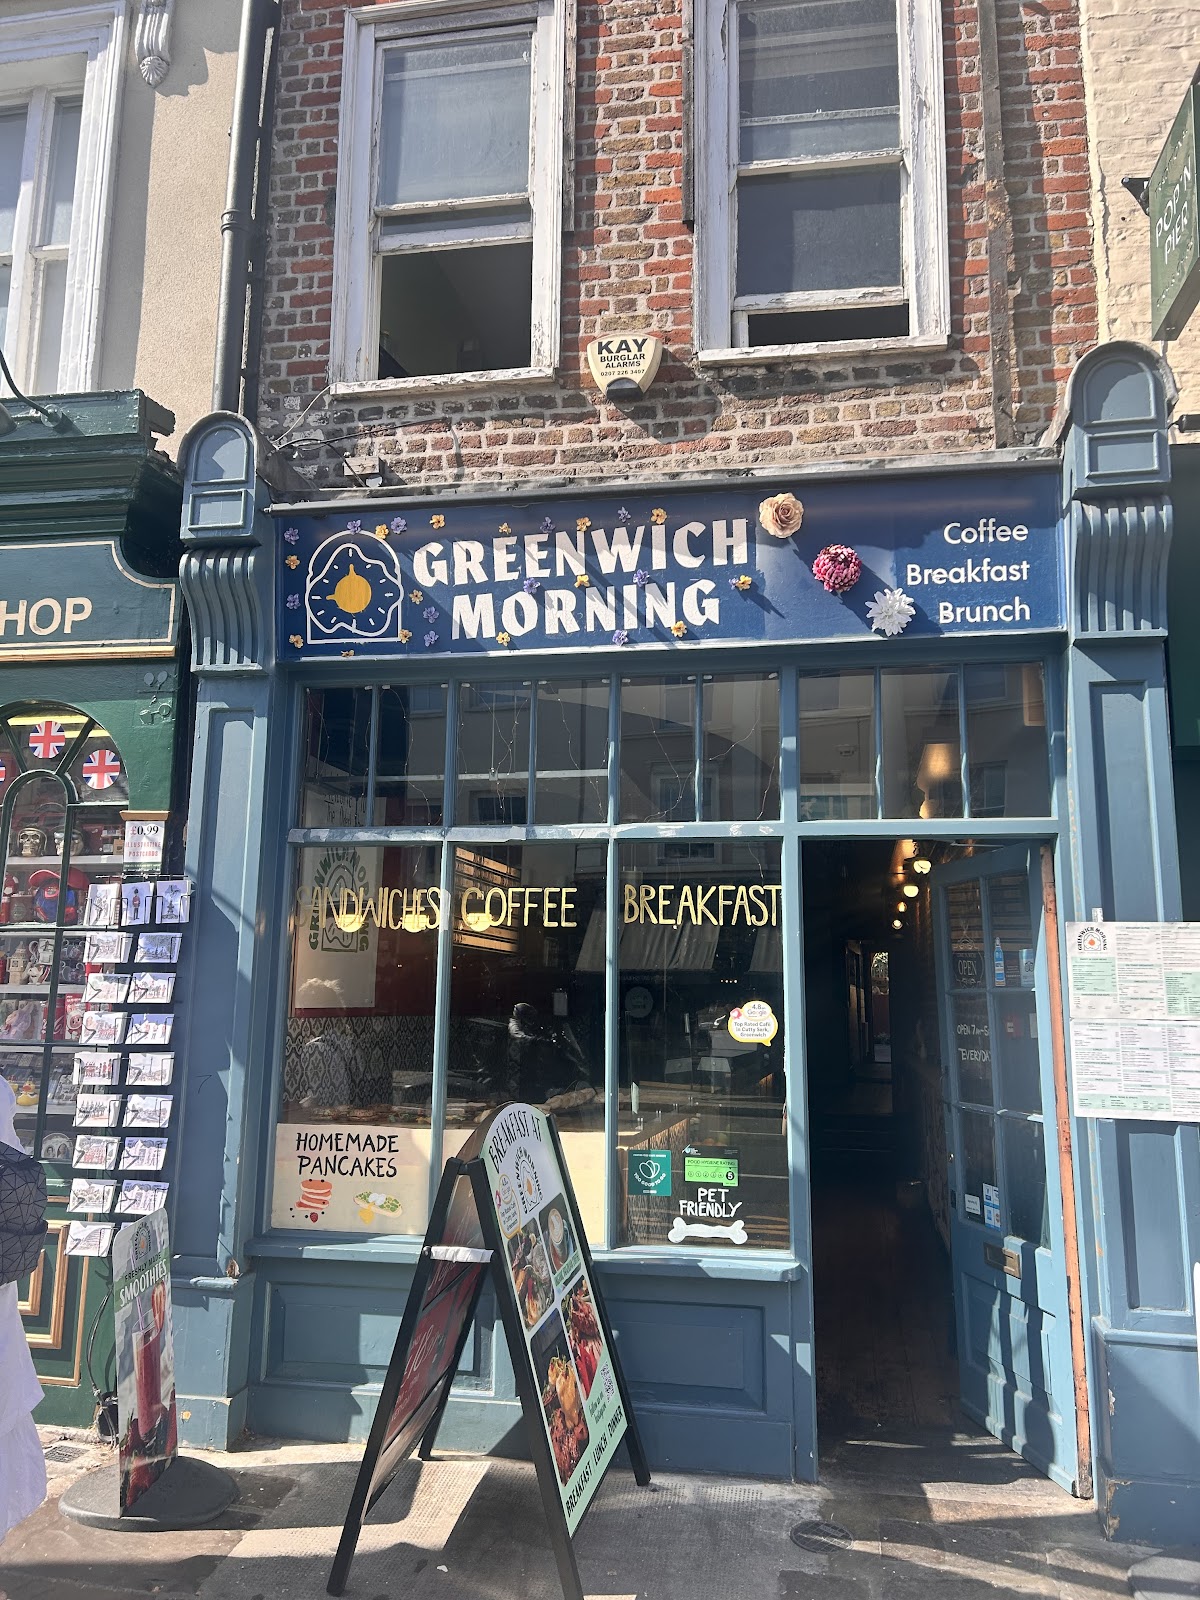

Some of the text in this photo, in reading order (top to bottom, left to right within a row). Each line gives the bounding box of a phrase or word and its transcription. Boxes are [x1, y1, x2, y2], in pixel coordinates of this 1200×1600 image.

[1156, 156, 1192, 248] POP'N
[1165, 201, 1189, 265] PIER
[597, 337, 648, 355] KAY
[600, 353, 646, 363] BURGLAR
[605, 360, 641, 369] ALARMS
[943, 517, 1029, 545] Coffee
[413, 518, 748, 587] GREENWICH
[906, 557, 1031, 586] Breakfast
[451, 578, 721, 640] MORNING
[939, 595, 1031, 624] Brunch
[130, 825, 159, 836] £0.99
[296, 885, 442, 930] SANDWICHES
[461, 887, 578, 928] COFFEE
[624, 884, 782, 927] BREAKFAST
[958, 960, 977, 976] OPEN
[957, 1024, 971, 1035] OPEN
[296, 1132, 399, 1152] HOMEMADE
[488, 1110, 542, 1174] BREAKFAST AT
[297, 1154, 397, 1177] PANCAKES
[679, 1200, 742, 1217] FRIENDLY
[697, 1187, 729, 1203] PET
[124, 1251, 162, 1280] FRESHLY MADE
[119, 1258, 167, 1307] SMOOTHIES
[565, 1405, 623, 1519] BREAKFAST LUNCH DINNER
